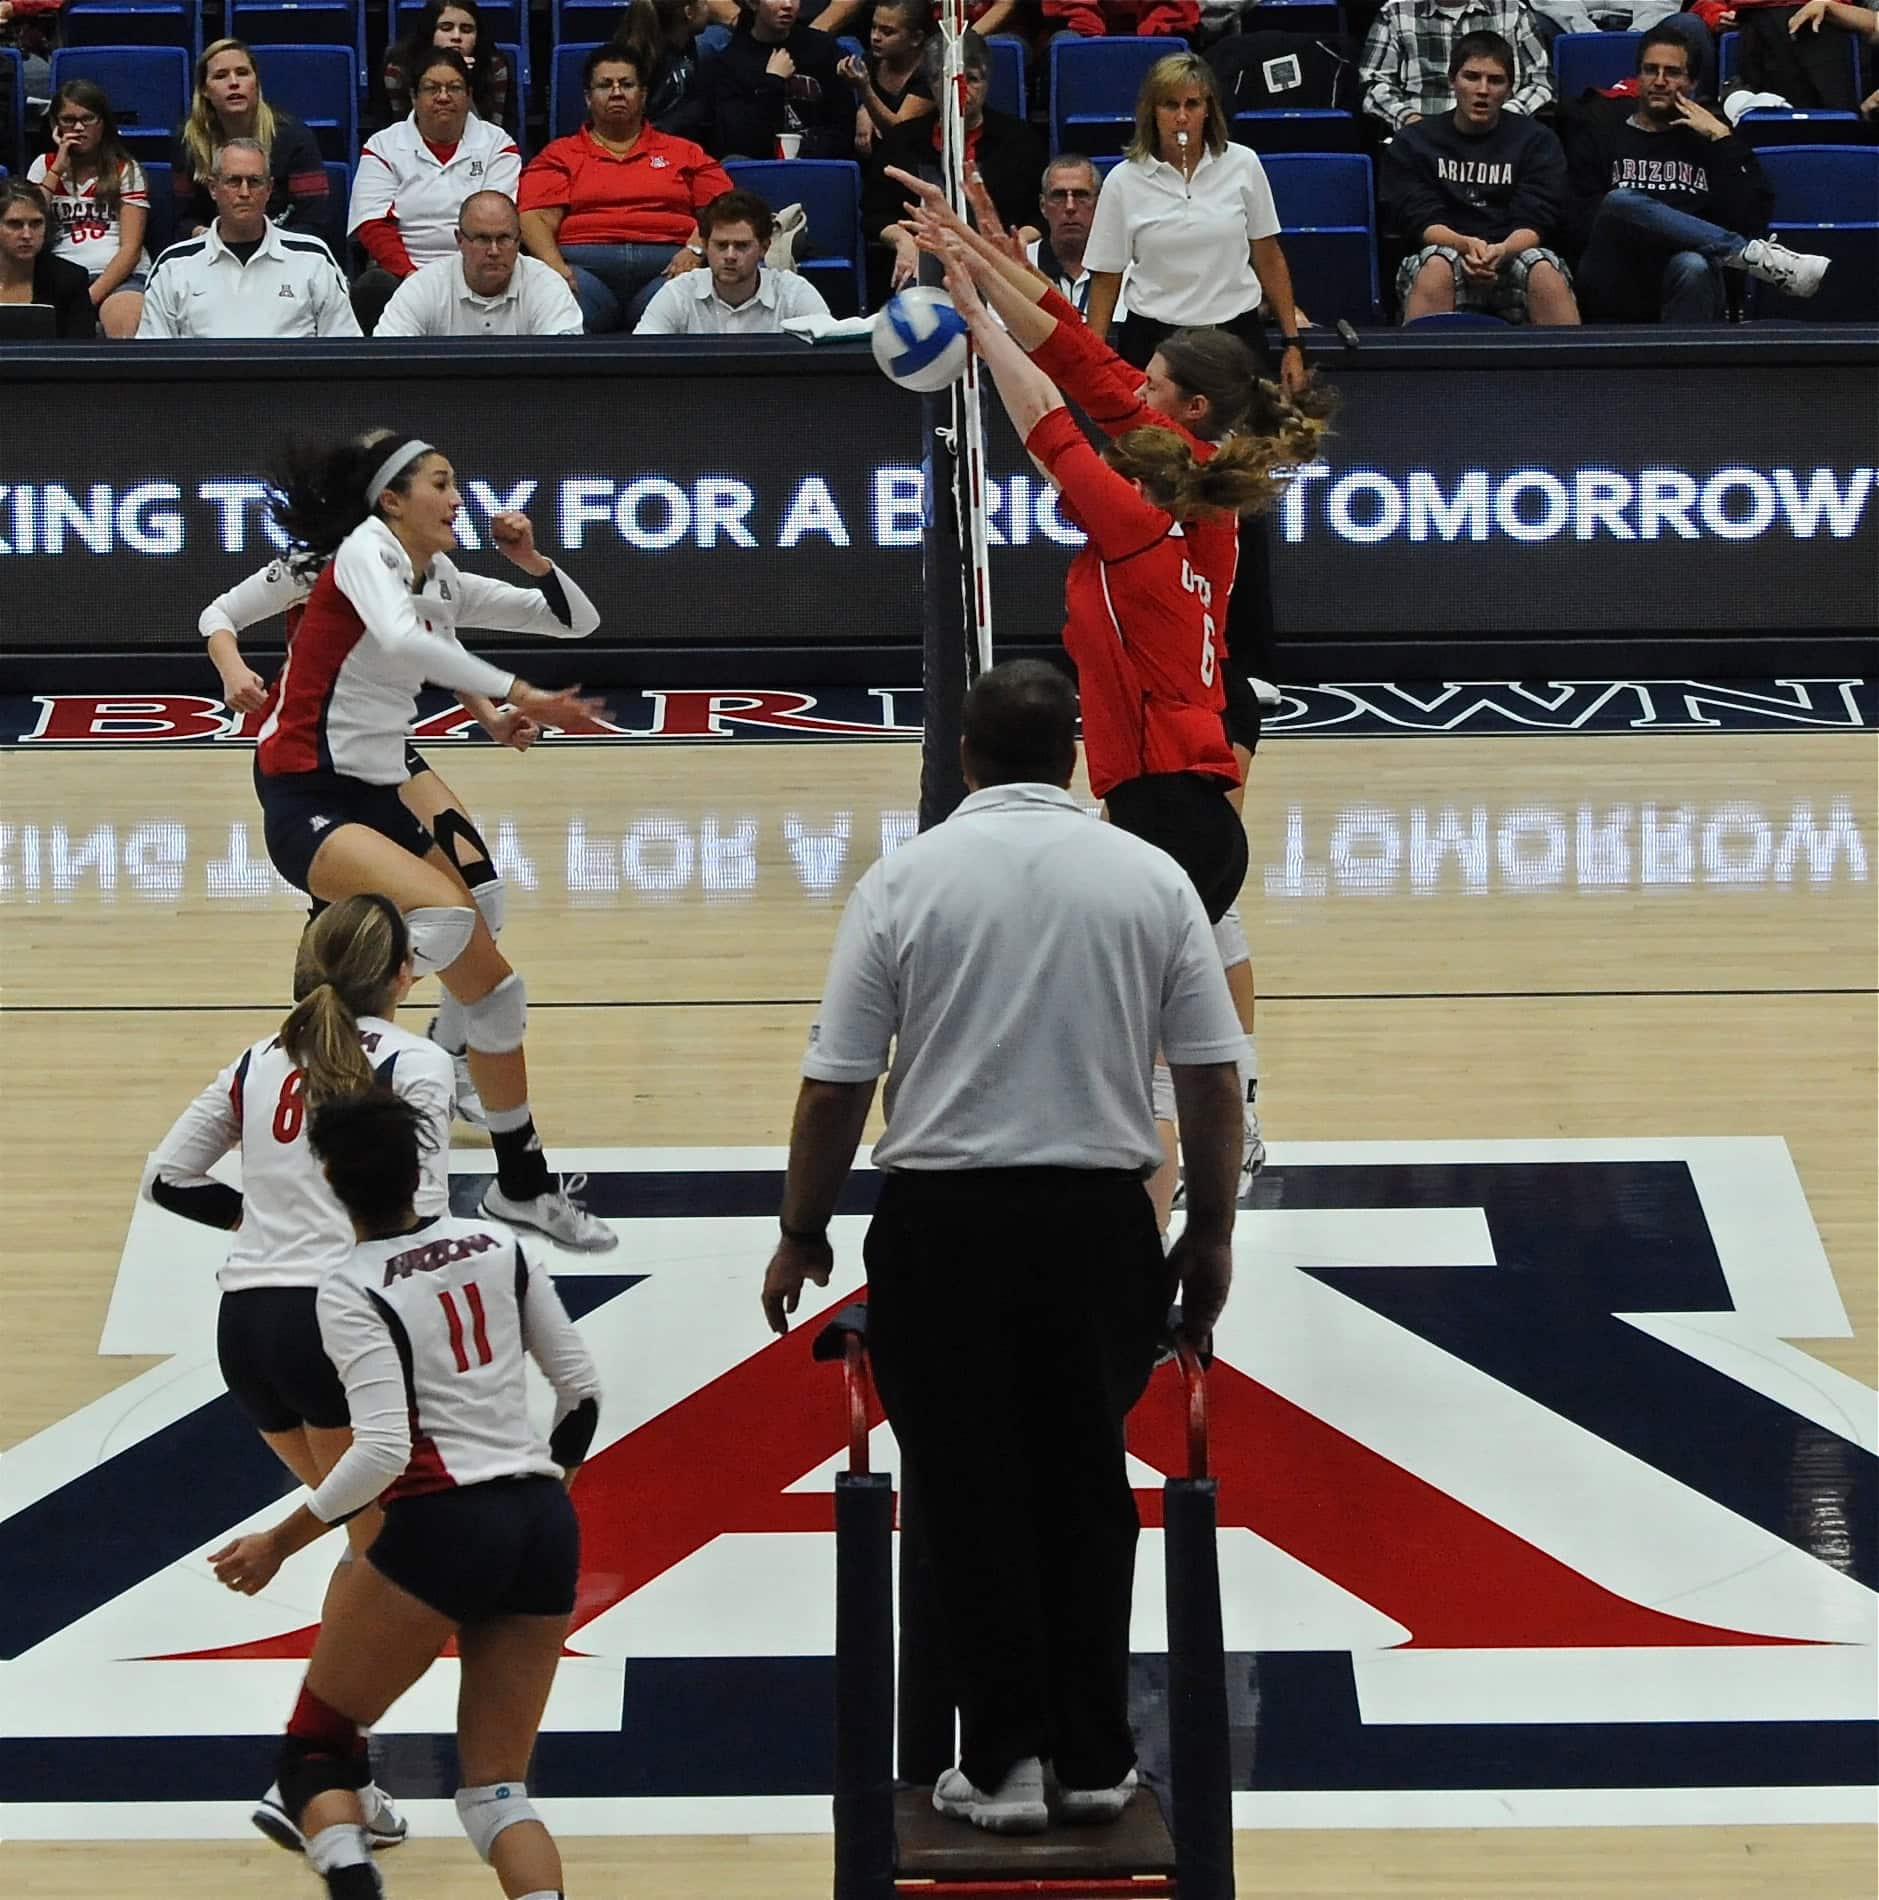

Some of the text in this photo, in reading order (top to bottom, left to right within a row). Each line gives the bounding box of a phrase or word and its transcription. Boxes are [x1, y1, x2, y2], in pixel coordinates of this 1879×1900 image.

[1438, 157, 1512, 185] ARIZONA
[1611, 158, 1709, 192] ARIZONA
[0, 482, 185, 554] ING
[558, 476, 760, 550] FOR
[775, 475, 851, 547] A
[1268, 466, 1879, 545] TOMORROW
[1200, 611, 1216, 689] 6
[382, 1233, 502, 1288] ARIZONA
[437, 1281, 494, 1373] 11
